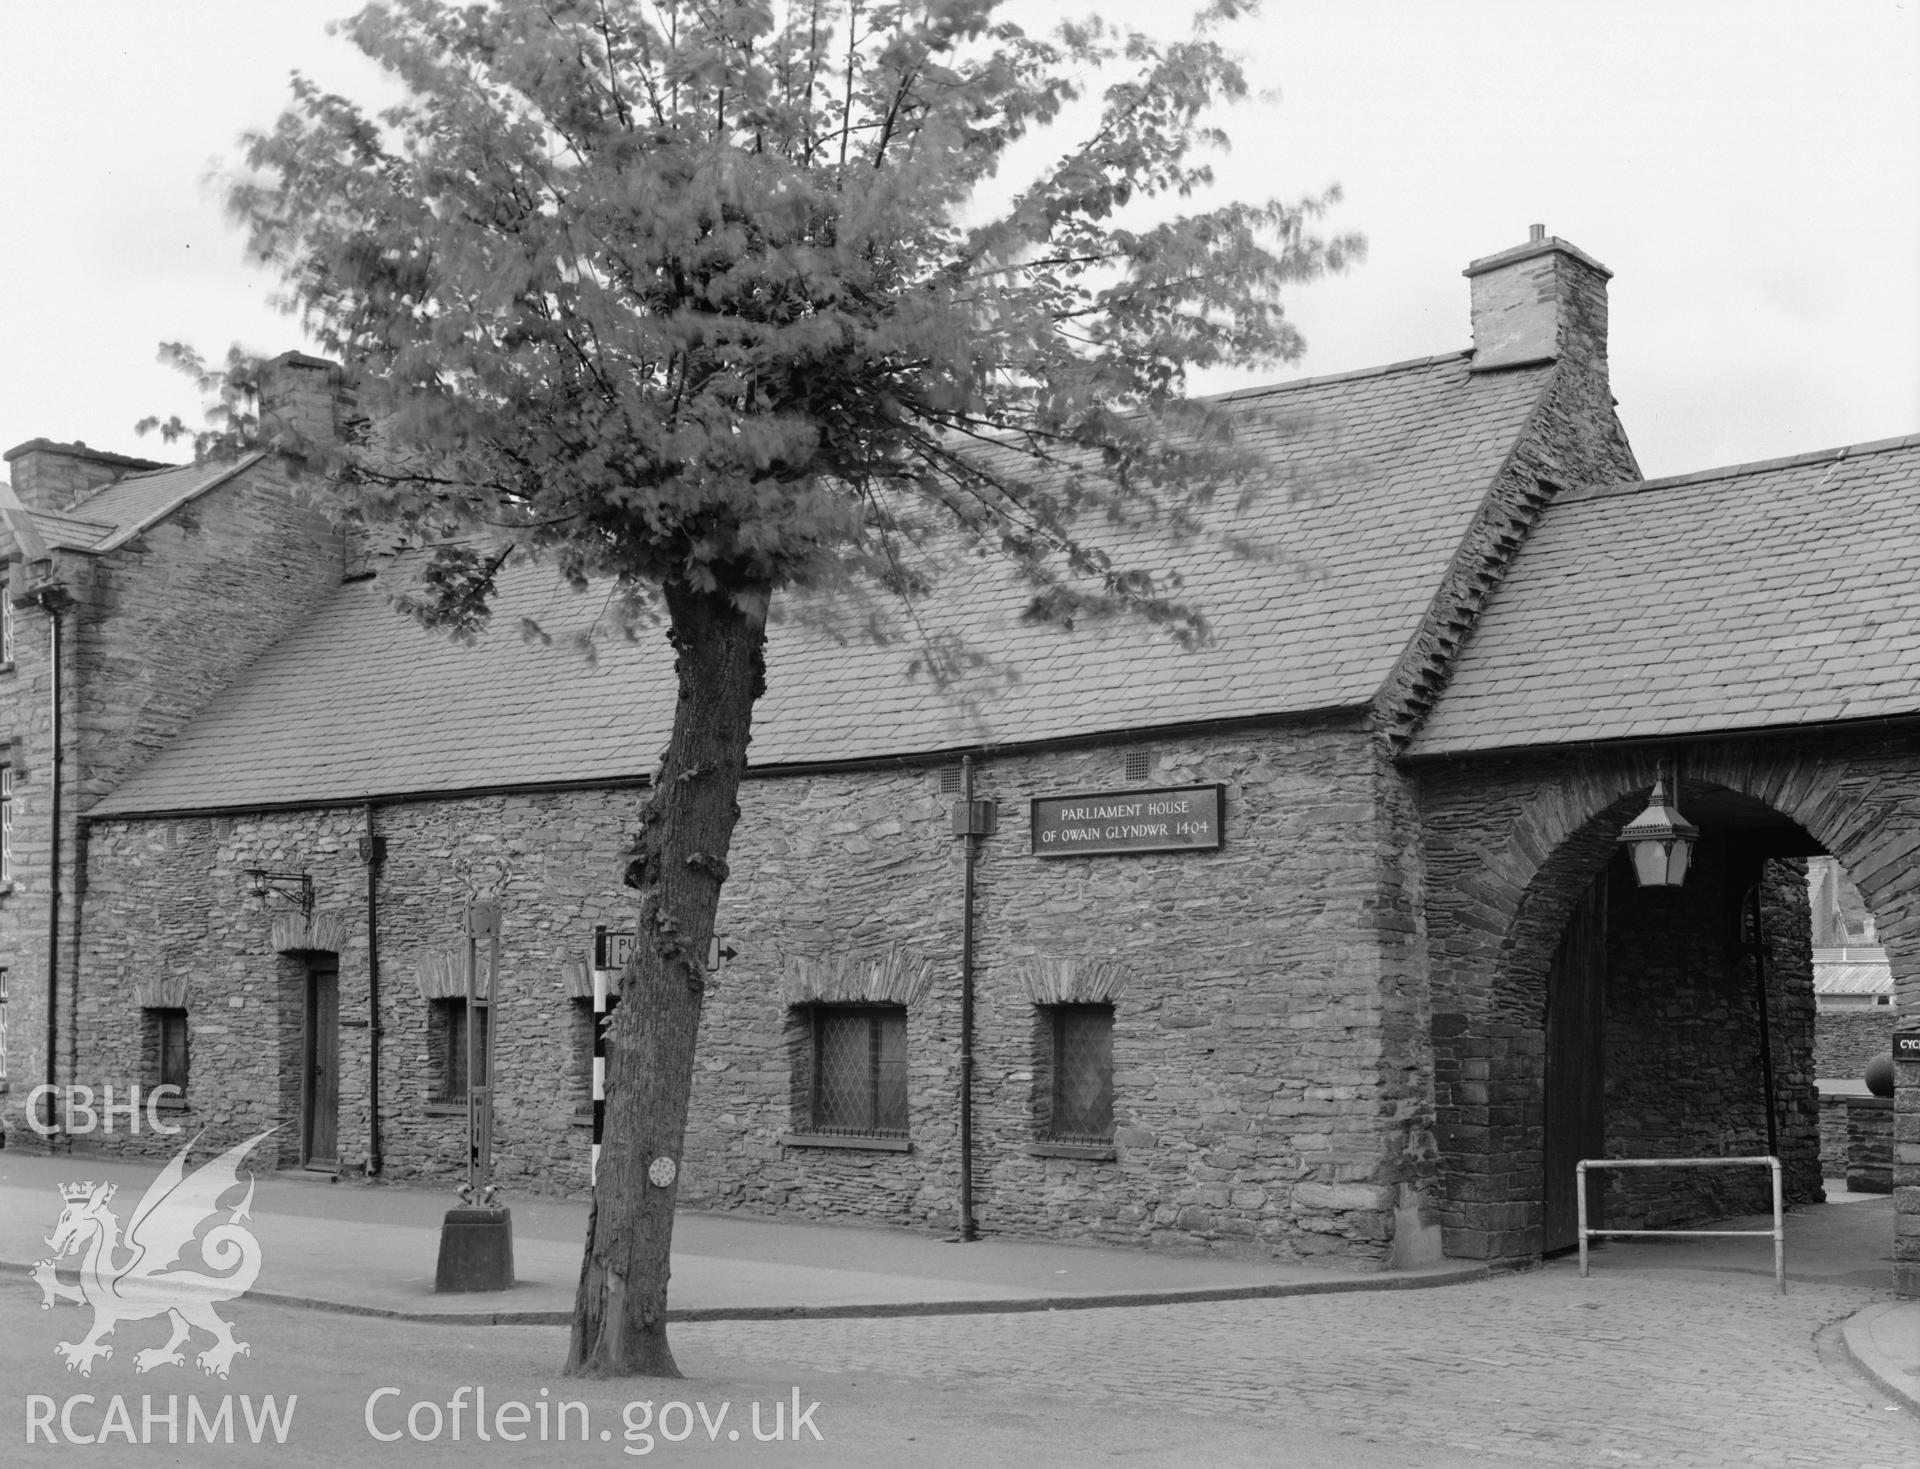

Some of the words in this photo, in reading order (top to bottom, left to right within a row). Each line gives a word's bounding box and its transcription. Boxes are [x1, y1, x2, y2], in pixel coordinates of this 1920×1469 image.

[1061, 804, 1142, 821] PARLIAMENT
[1149, 800, 1190, 815] HOUSE
[1042, 829, 1057, 843] OF
[1061, 827, 1100, 842] OWAIN
[1105, 823, 1169, 839] GLYNDWR
[1175, 820, 1209, 835] 1404
[1900, 1039, 1920, 1049] CYC
